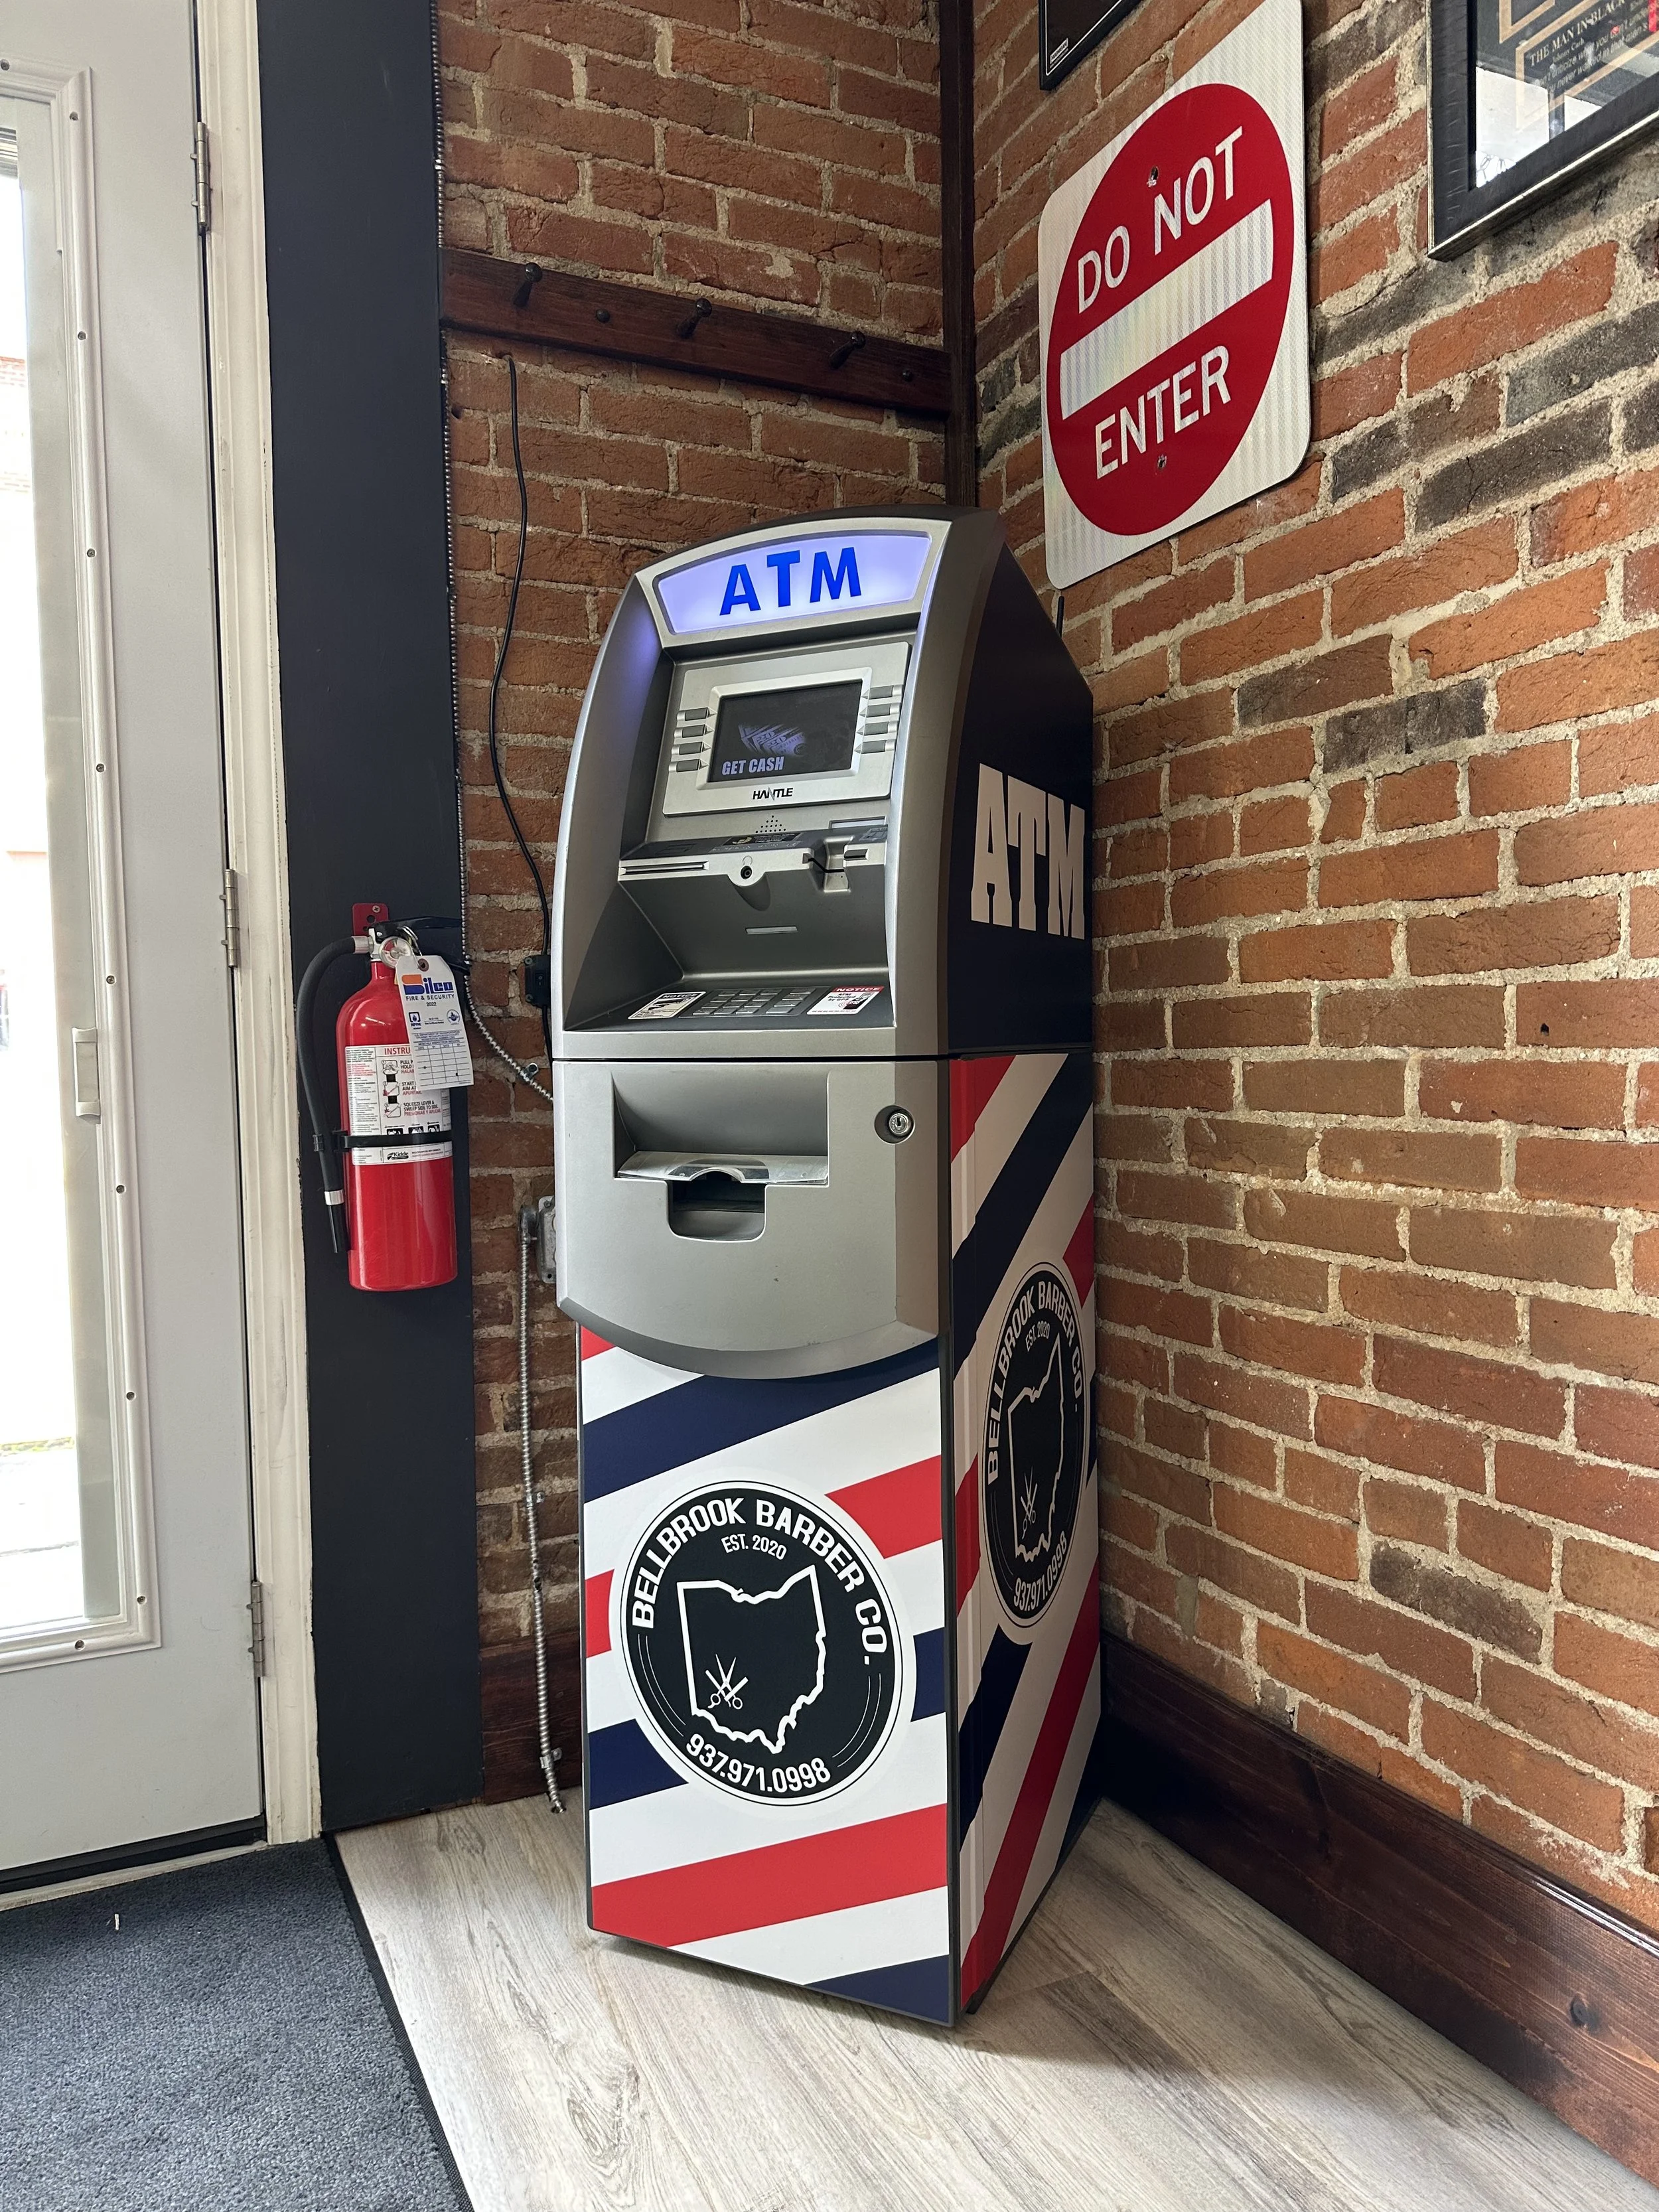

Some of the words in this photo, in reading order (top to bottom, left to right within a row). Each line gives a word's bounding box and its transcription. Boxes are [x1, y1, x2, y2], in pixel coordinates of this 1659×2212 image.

[1530, 44, 1550, 67] THE
[1552, 26, 1574, 52] MAN
[1078, 225, 1130, 315] DO
[1154, 125, 1243, 256] NOT
[1095, 344, 1232, 480] ENTER
[719, 547, 862, 617] ATM
[721, 760, 747, 776] GET
[748, 756, 785, 773] CASH
[753, 786, 794, 801] HANTLE
[971, 763, 1086, 940] ATM
[1025, 1324, 1037, 1352] EST.
[1037, 1320, 1050, 1339] 2020
[987, 1286, 1035, 1485] BELLBROOK
[1038, 1281, 1076, 1347] BARBER
[1072, 1346, 1082, 1412] CO.
[632, 1497, 747, 1629] BELLBROOK
[755, 1499, 865, 1593] BARBER
[855, 1597, 887, 1665] CO.
[721, 1533, 749, 1554] EST.
[752, 1534, 788, 1560] 2020
[1014, 1530, 1067, 1611] 937.971.0998
[685, 1733, 831, 1793] 937.971.0998
